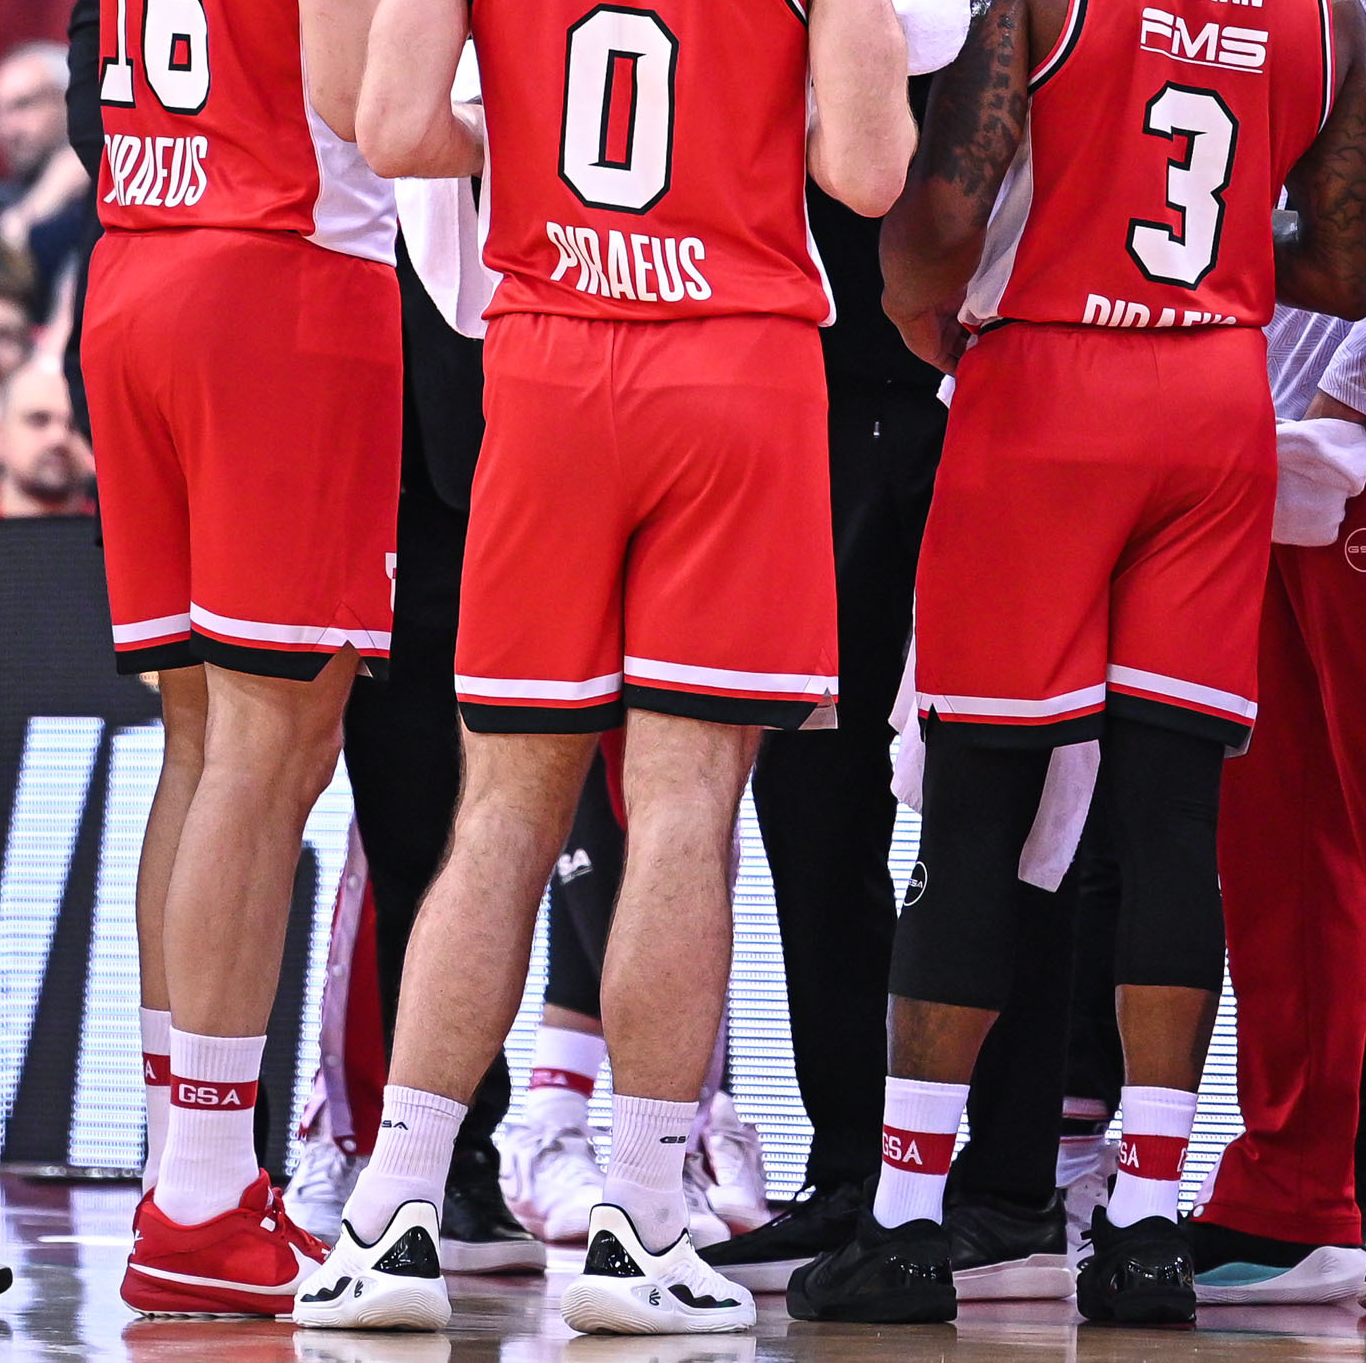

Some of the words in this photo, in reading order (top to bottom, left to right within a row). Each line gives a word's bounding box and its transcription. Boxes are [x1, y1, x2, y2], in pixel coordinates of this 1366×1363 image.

[1140, 6, 1269, 74] FMS
[557, 4, 679, 215] 0
[1125, 81, 1240, 290] 3
[547, 222, 712, 303] PIRAEUS
[178, 1083, 241, 1105] GSA
